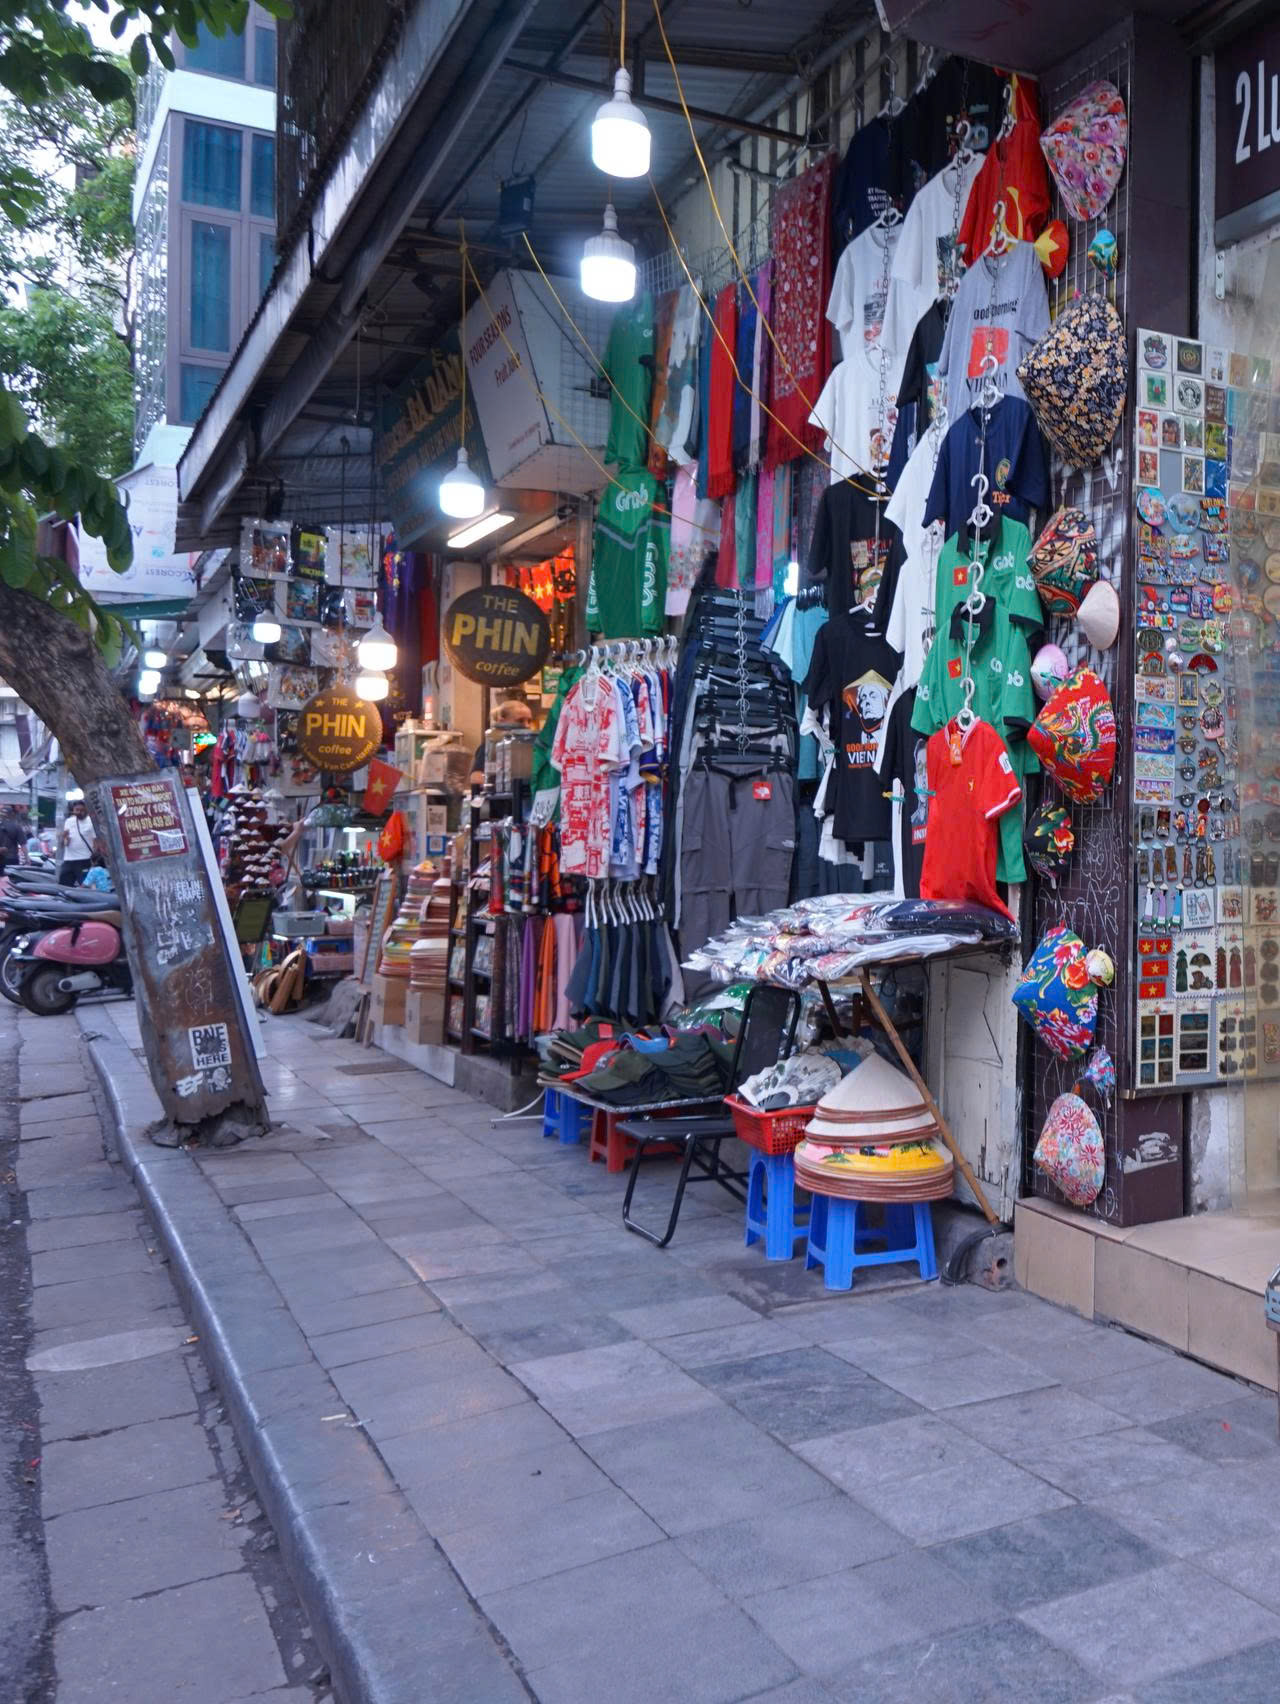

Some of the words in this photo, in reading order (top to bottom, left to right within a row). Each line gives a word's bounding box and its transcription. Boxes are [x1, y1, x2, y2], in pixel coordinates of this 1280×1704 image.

[1235, 71, 1251, 164] 2
[615, 483, 649, 512] Grab
[482, 594, 519, 614] THE
[452, 613, 540, 656] PHIN
[475, 659, 521, 677] coffee
[332, 697, 348, 707] THE
[306, 712, 366, 738] PHIN
[318, 744, 353, 756] coffee
[196, 1053, 229, 1067] HERE
